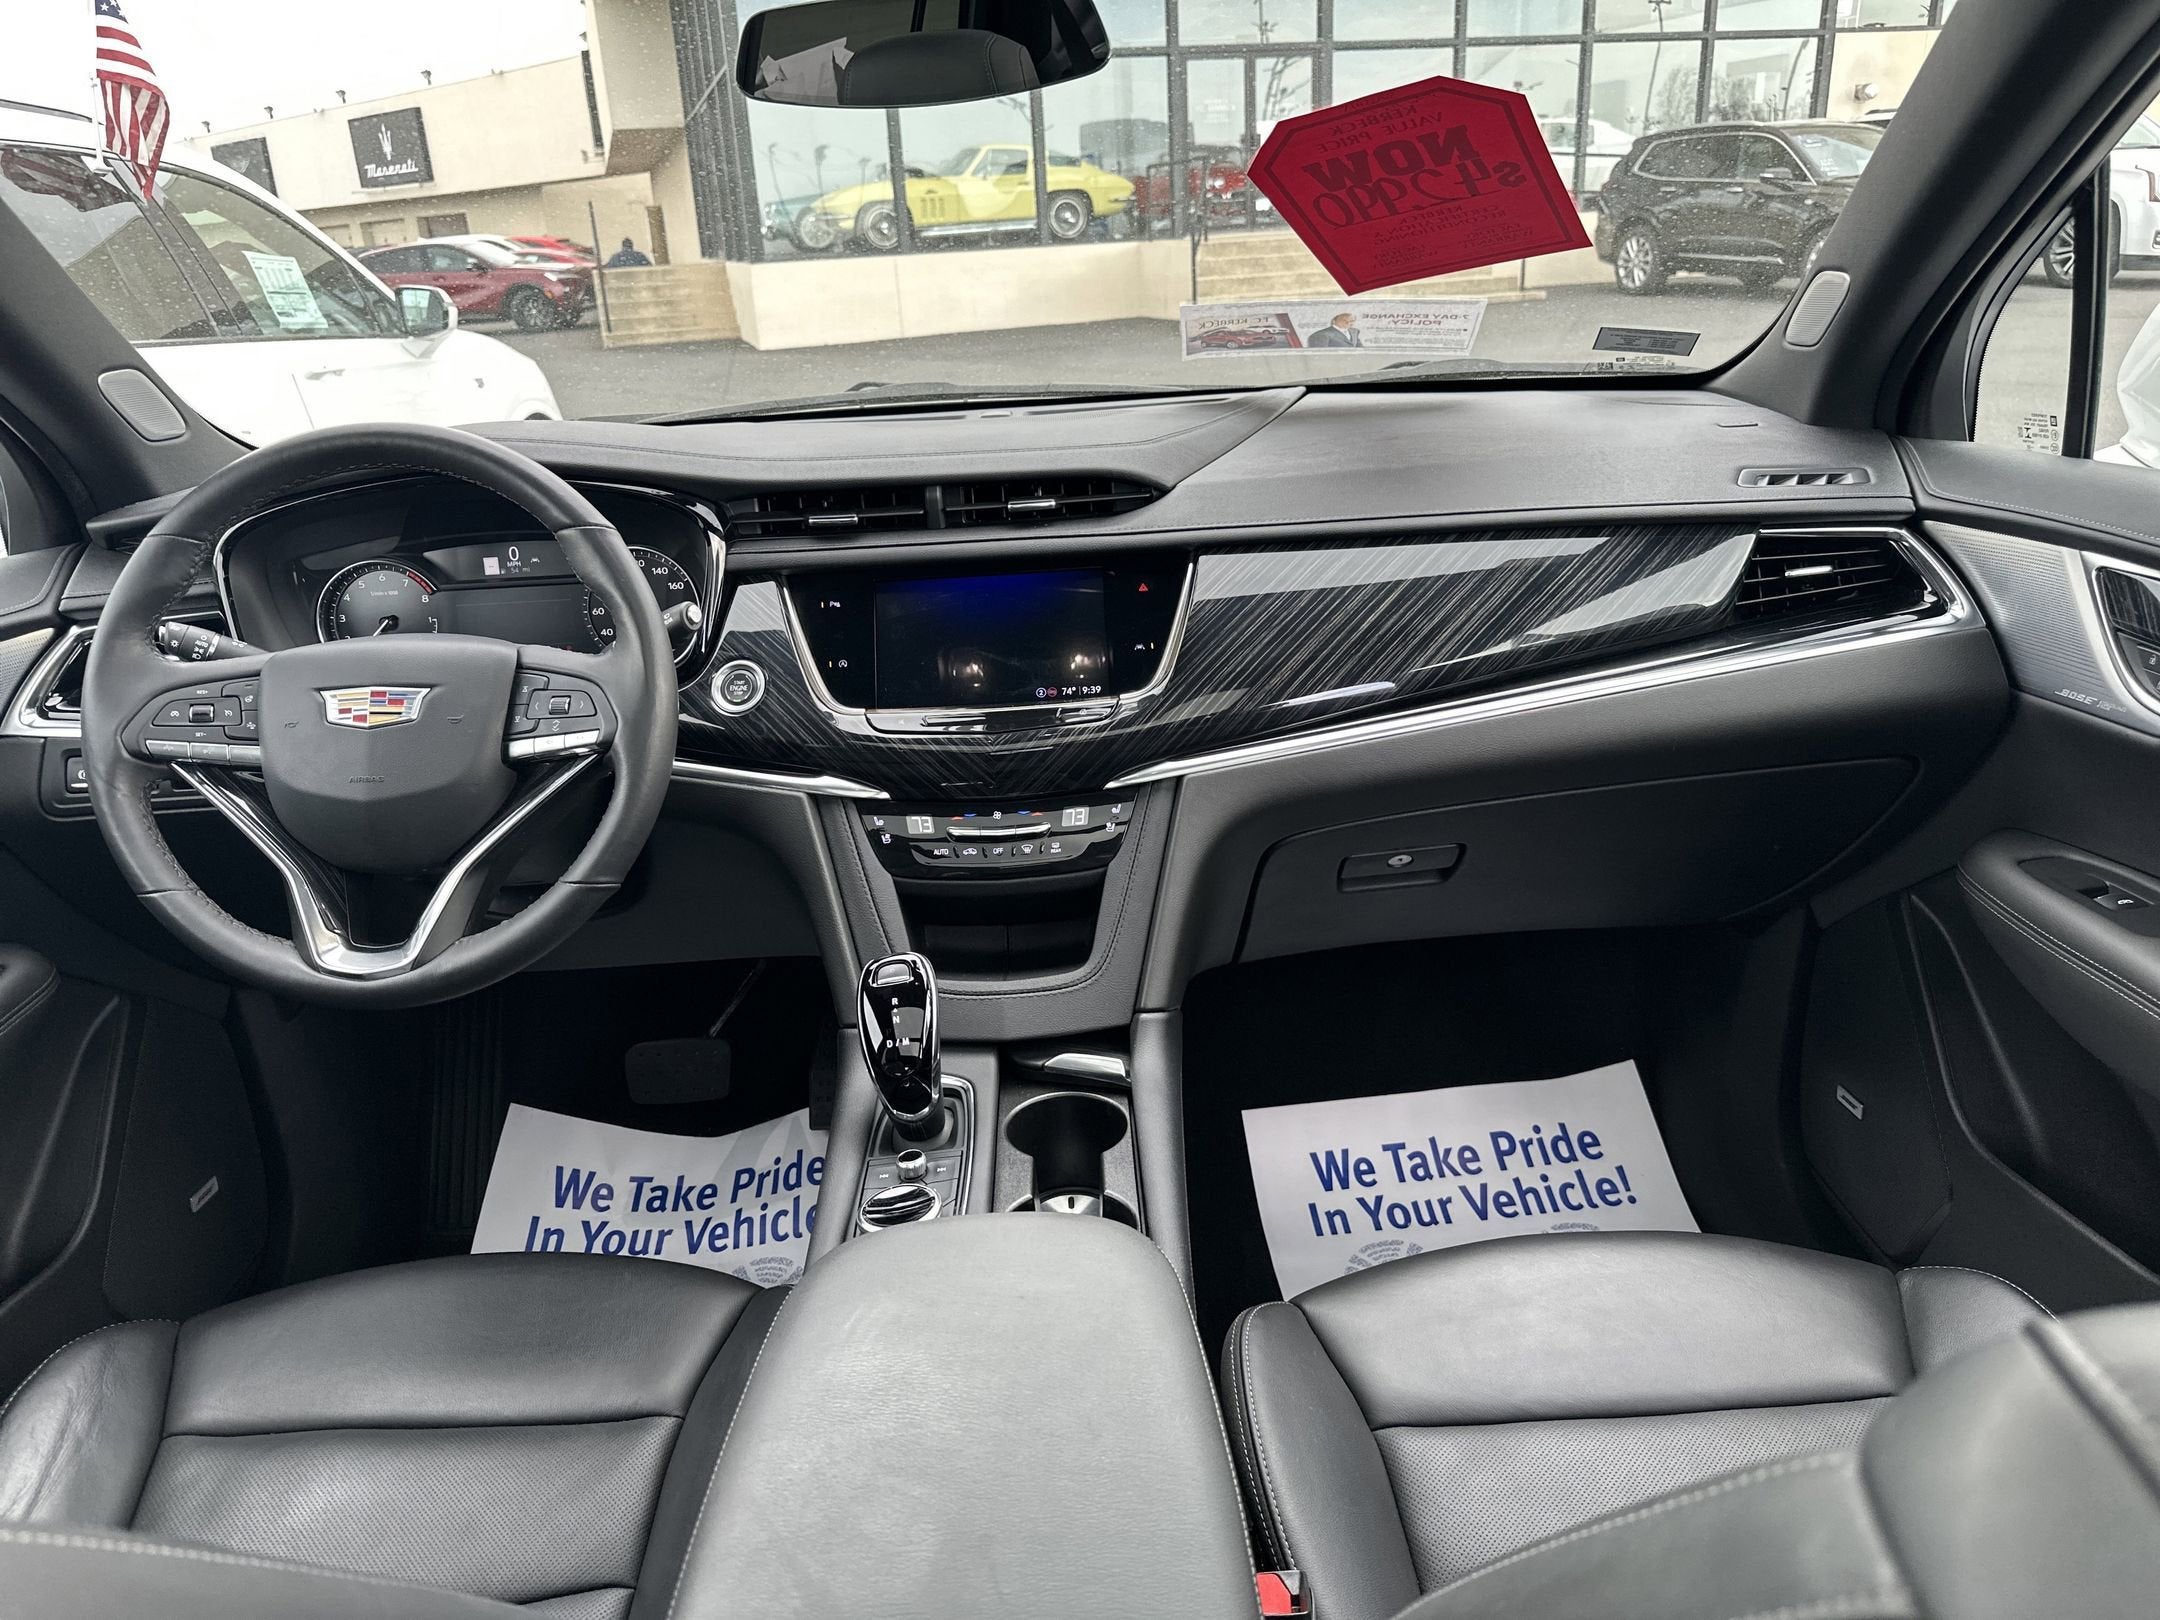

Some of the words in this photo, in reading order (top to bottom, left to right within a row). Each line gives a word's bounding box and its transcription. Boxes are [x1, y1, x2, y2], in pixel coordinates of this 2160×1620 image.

[364, 158, 419, 178] Maserati
[508, 546, 519, 561] 0
[651, 567, 668, 575] 140
[379, 573, 386, 582] 6
[358, 581, 365, 589] 5
[402, 579, 409, 587] 7
[667, 582, 684, 590] 160
[343, 593, 350, 601] 4
[421, 594, 429, 603] 8
[592, 607, 605, 615] 60
[339, 614, 346, 622] 3
[600, 628, 613, 636] 40
[194, 640, 208, 648] AUTO
[1082, 685, 1101, 694] 9:39
[2054, 688, 2098, 705] BOSE
[1065, 808, 1085, 825] 73
[911, 816, 932, 833] 73
[992, 847, 1004, 855] OFF
[891, 997, 898, 1005] R
[892, 1015, 900, 1024] N
[1309, 1148, 1378, 1192] We
[1381, 1136, 1482, 1184] Take
[1489, 1122, 1604, 1172] Pride
[554, 1165, 615, 1213] We
[628, 1174, 718, 1213] Take
[730, 1149, 826, 1204] Pride
[1307, 1202, 1352, 1237] In
[1355, 1193, 1455, 1232] Your
[1458, 1165, 1638, 1222] Vehicle!
[524, 1215, 565, 1253] In
[580, 1219, 673, 1257] Your
